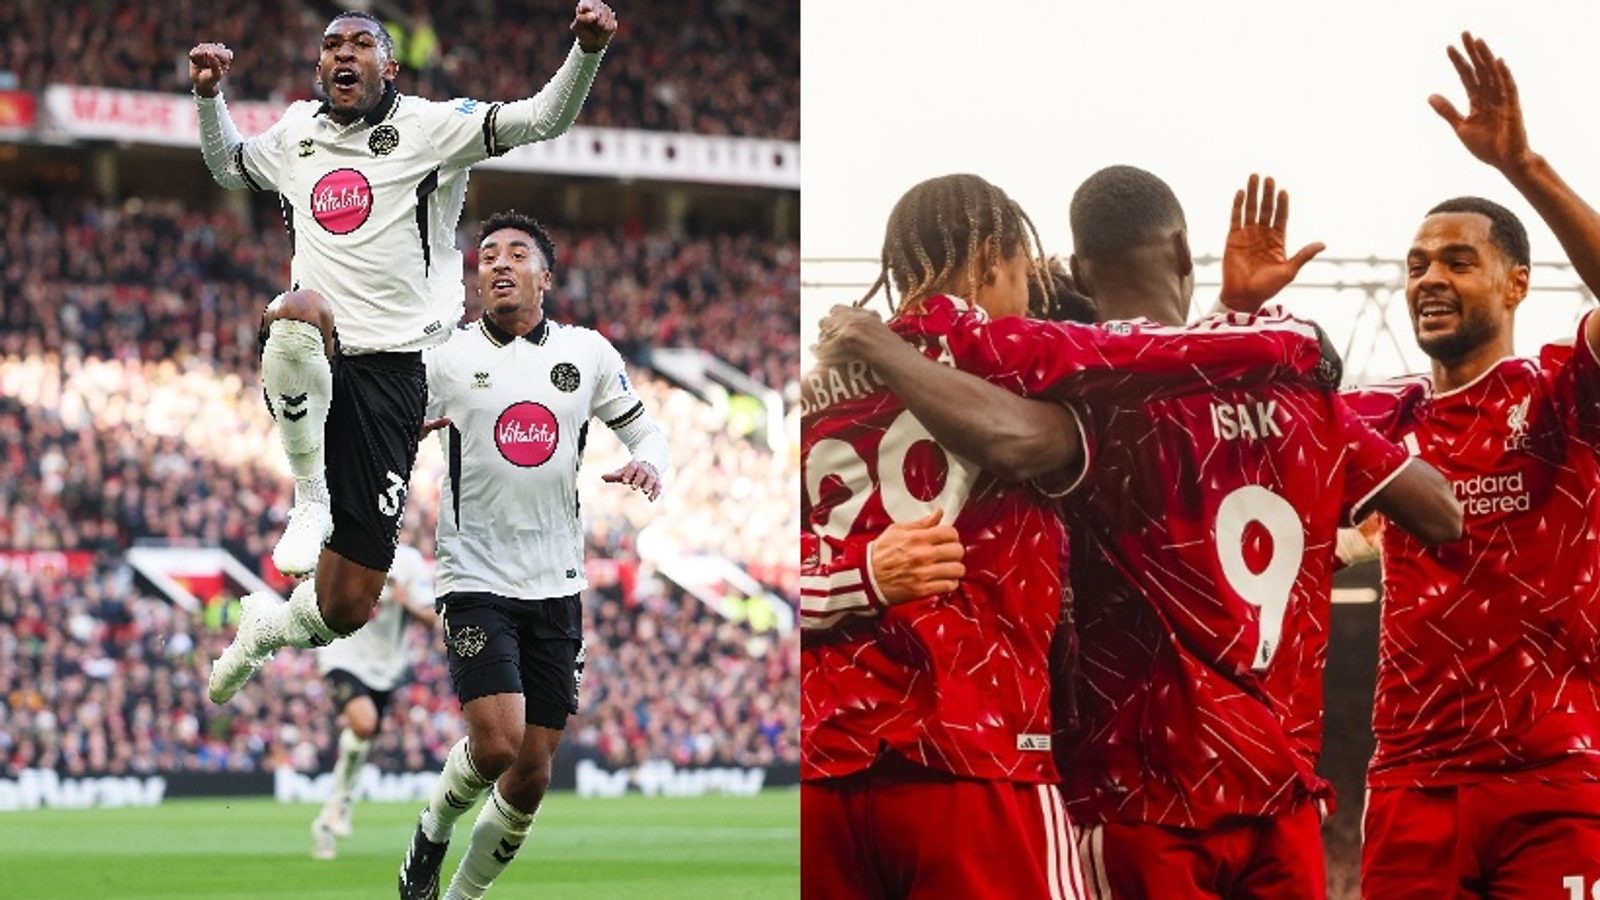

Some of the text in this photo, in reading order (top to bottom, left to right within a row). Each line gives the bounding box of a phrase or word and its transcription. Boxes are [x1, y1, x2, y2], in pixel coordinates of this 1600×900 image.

[313, 184, 370, 214] Vitality
[500, 418, 556, 450] Vitality
[1209, 400, 1284, 441] ISAK
[1453, 472, 1525, 496] ndard
[1461, 491, 1531, 516] rtered
[1215, 484, 1305, 669] 9
